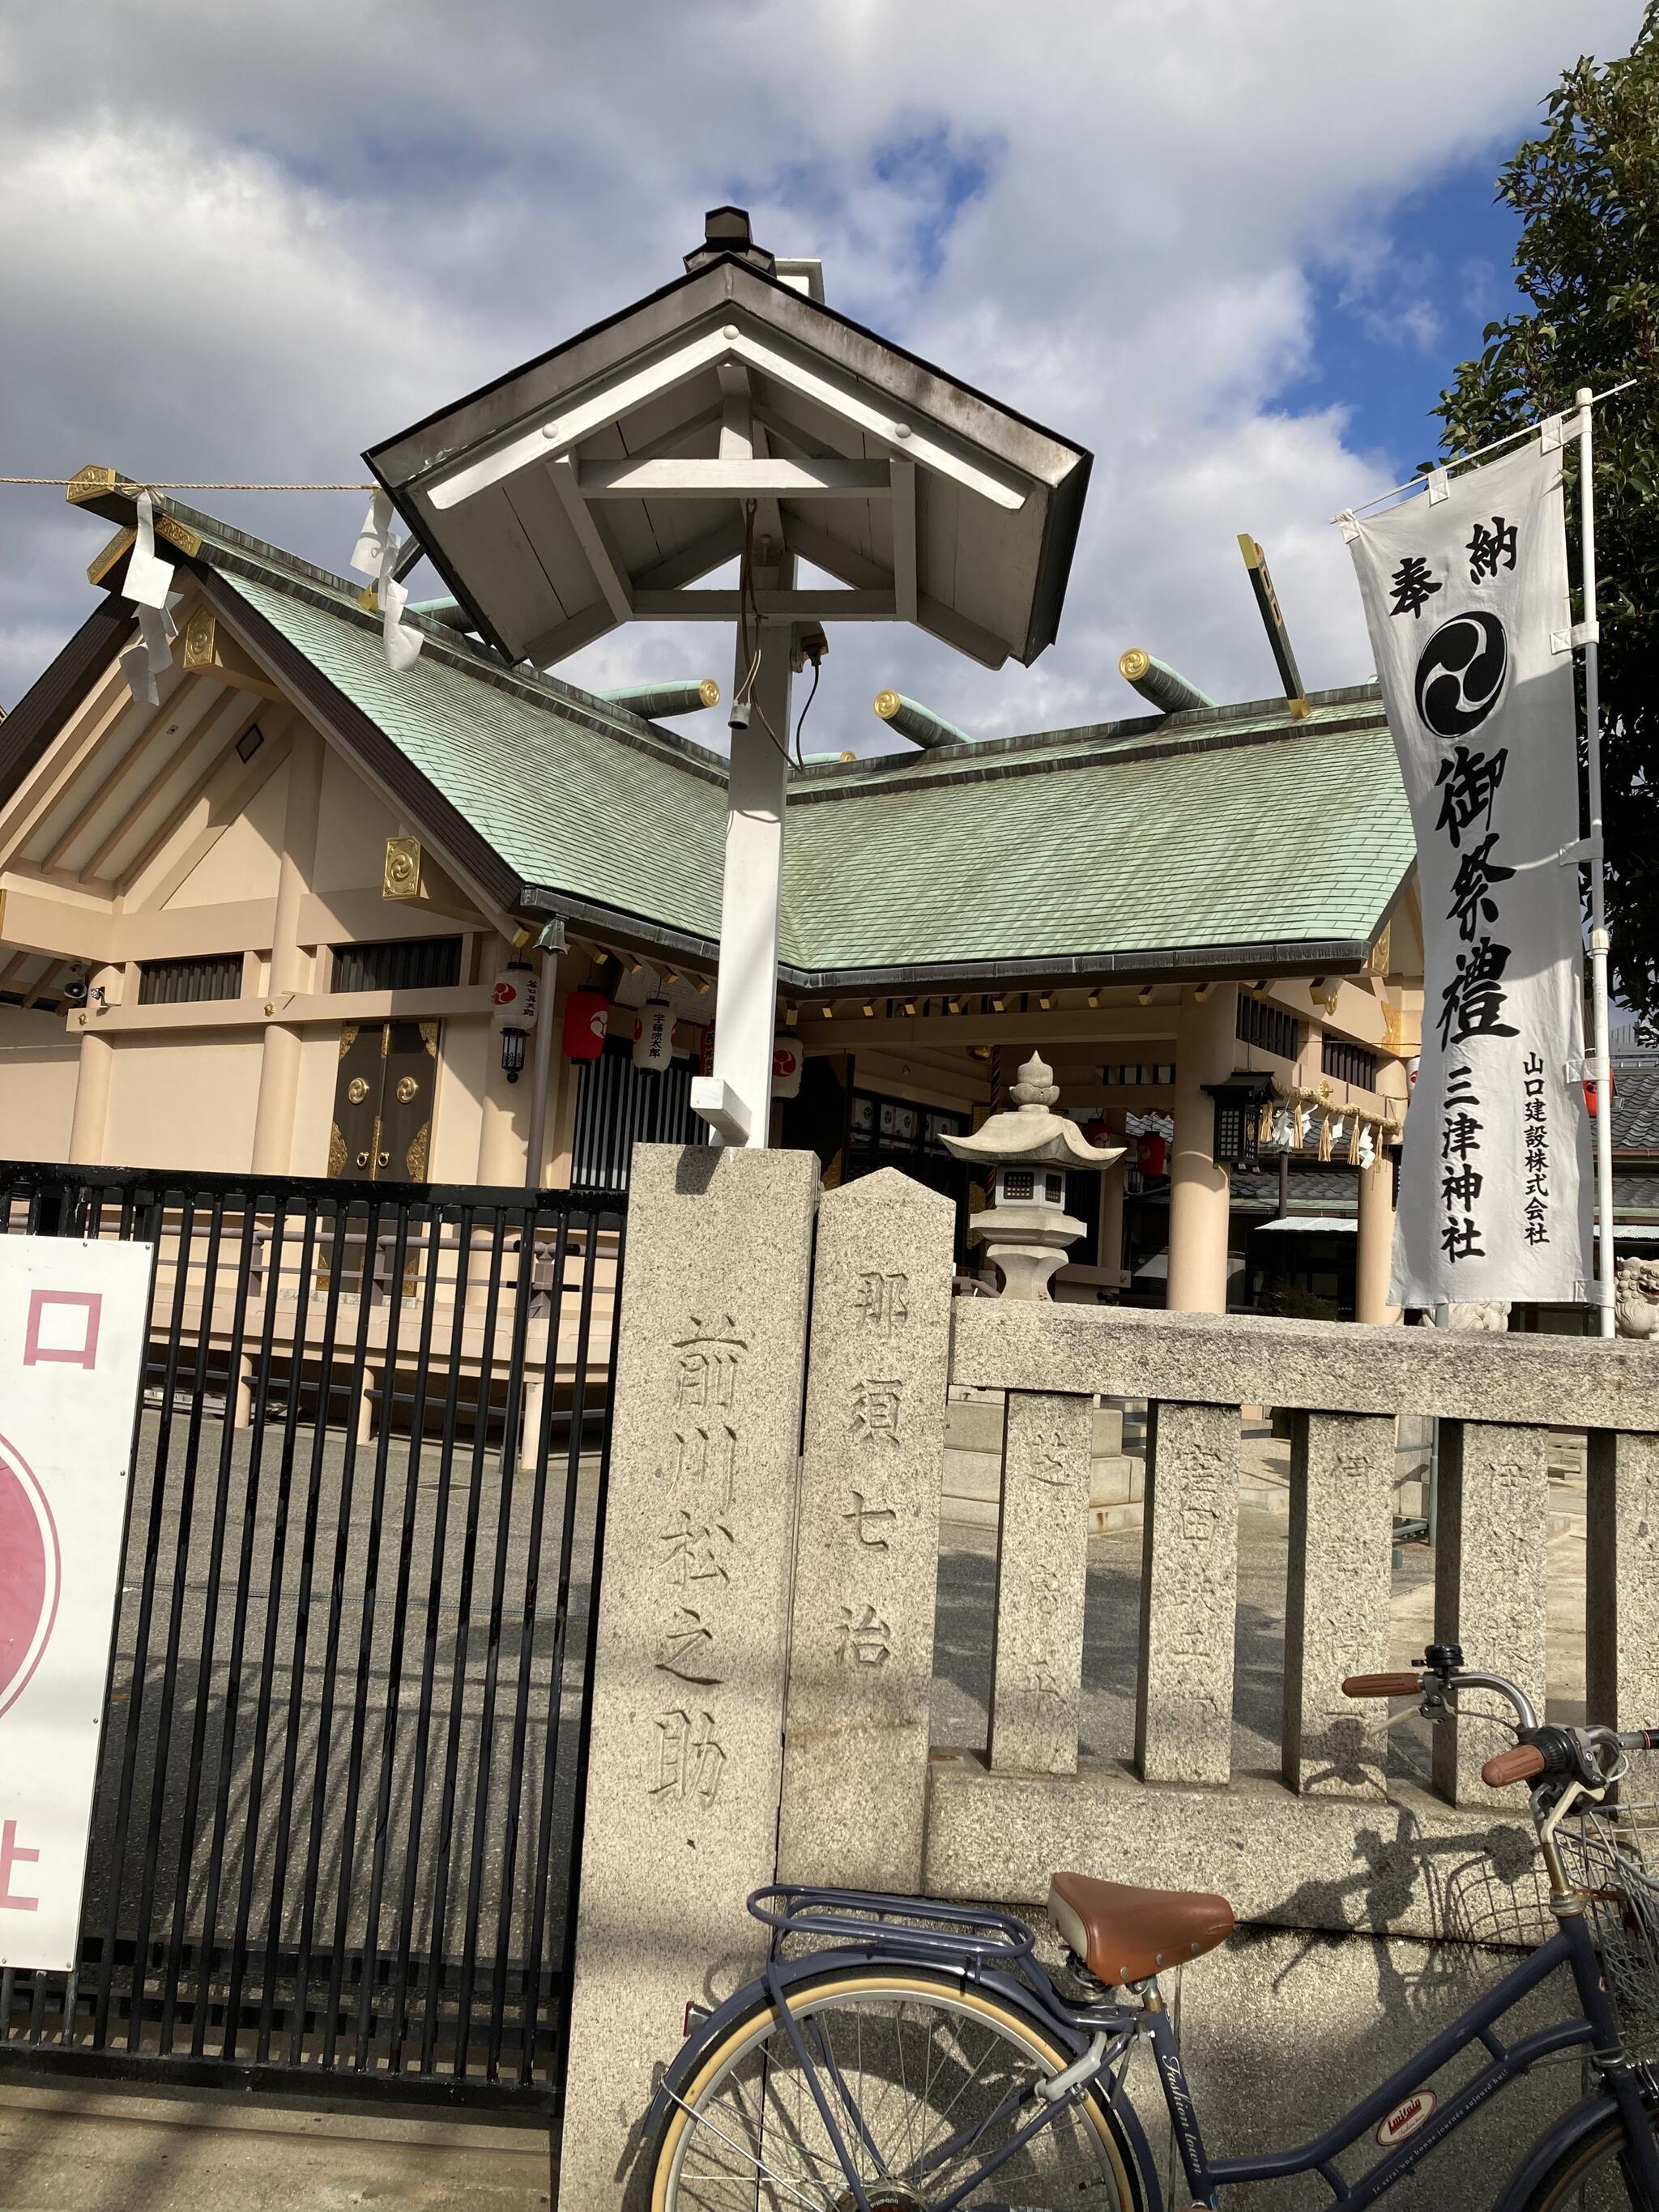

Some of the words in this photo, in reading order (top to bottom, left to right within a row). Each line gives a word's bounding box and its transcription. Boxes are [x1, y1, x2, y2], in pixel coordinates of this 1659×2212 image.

[1441, 1066, 1486, 1264] 三津神社
[1523, 1052, 1550, 1247] 山口建設株式会社
[23, 1289, 103, 1370] 口
[647, 1314, 749, 1810] 前川松之助
[834, 1271, 909, 1669] 那須七治
[1162, 2055, 1192, 2130] Fashion
[1184, 2132, 1203, 2176] town
[1414, 2133, 1437, 2158] bonne
